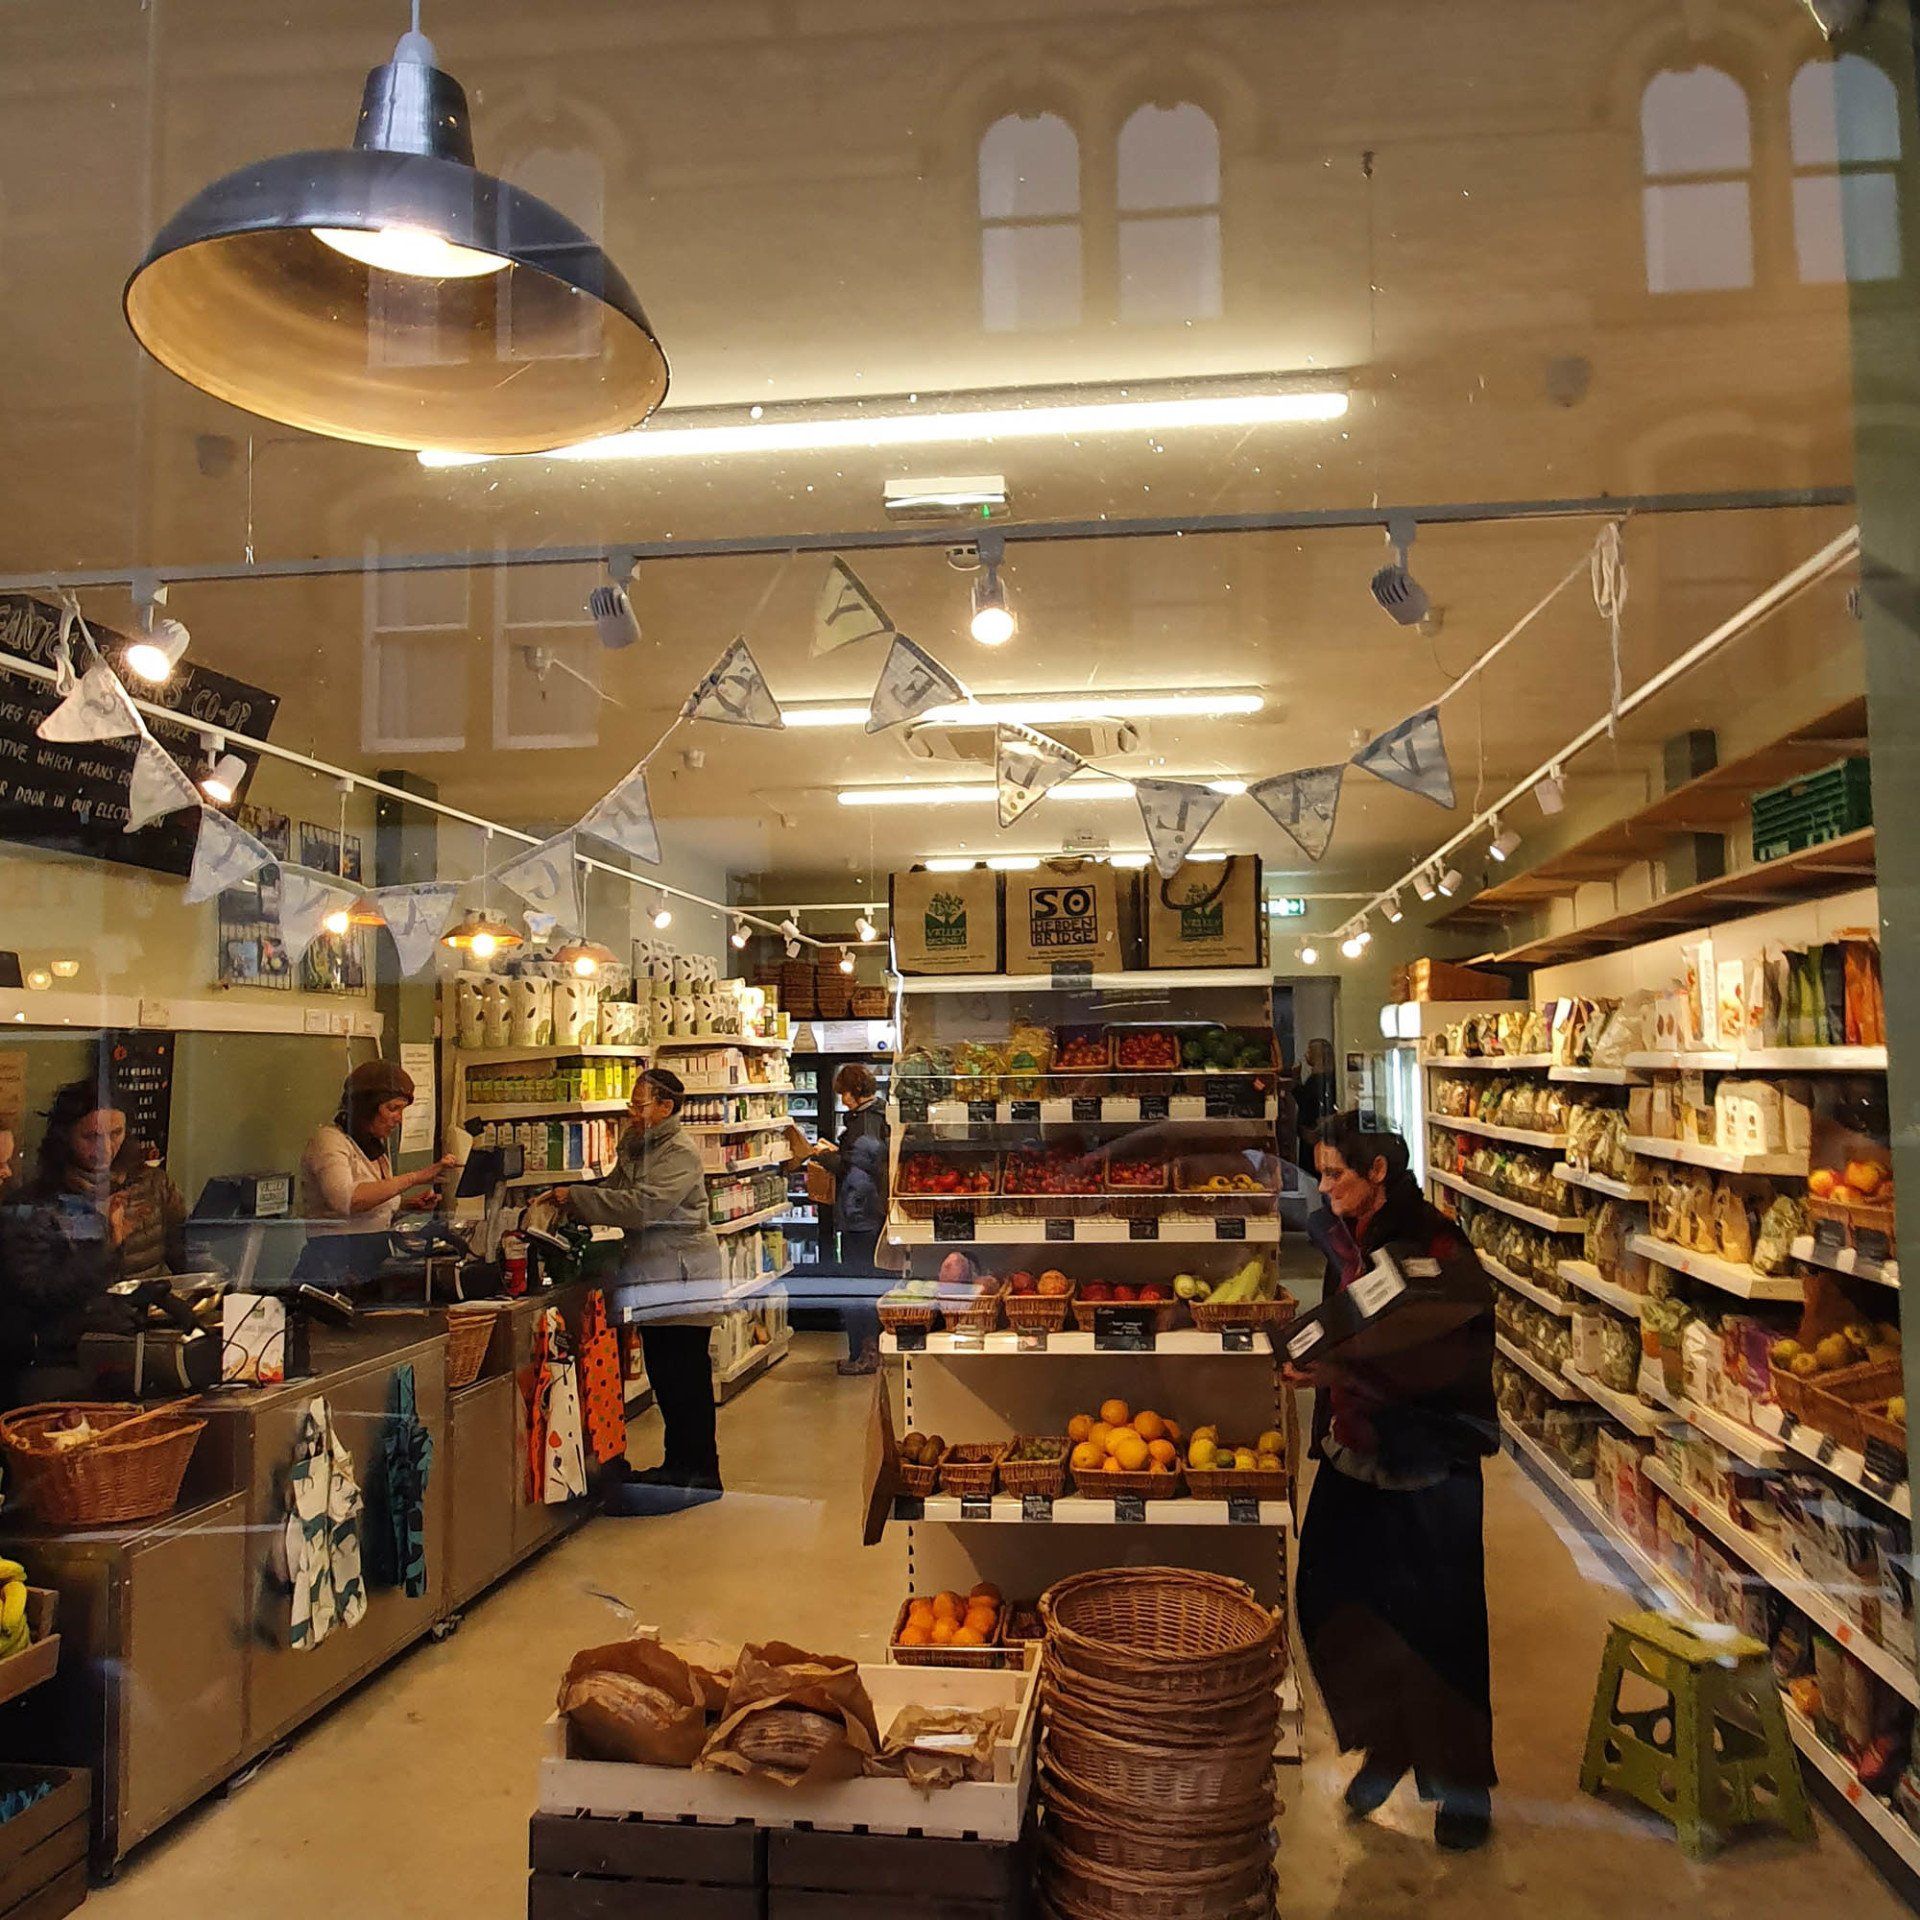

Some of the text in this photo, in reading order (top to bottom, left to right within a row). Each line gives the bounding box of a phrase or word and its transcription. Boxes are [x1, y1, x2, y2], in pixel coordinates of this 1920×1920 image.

[0, 701, 22, 721] VEG
[191, 688, 252, 733] CO-OP
[37, 750, 73, 771] WHICH
[78, 761, 114, 781] MEANS
[15, 786, 46, 807] DOOR
[54, 794, 66, 808] IN
[71, 798, 93, 816] OUR
[1034, 888, 1092, 919] SO
[1033, 918, 1094, 932] HEBDEN
[1033, 930, 1095, 945] BRIDGE
